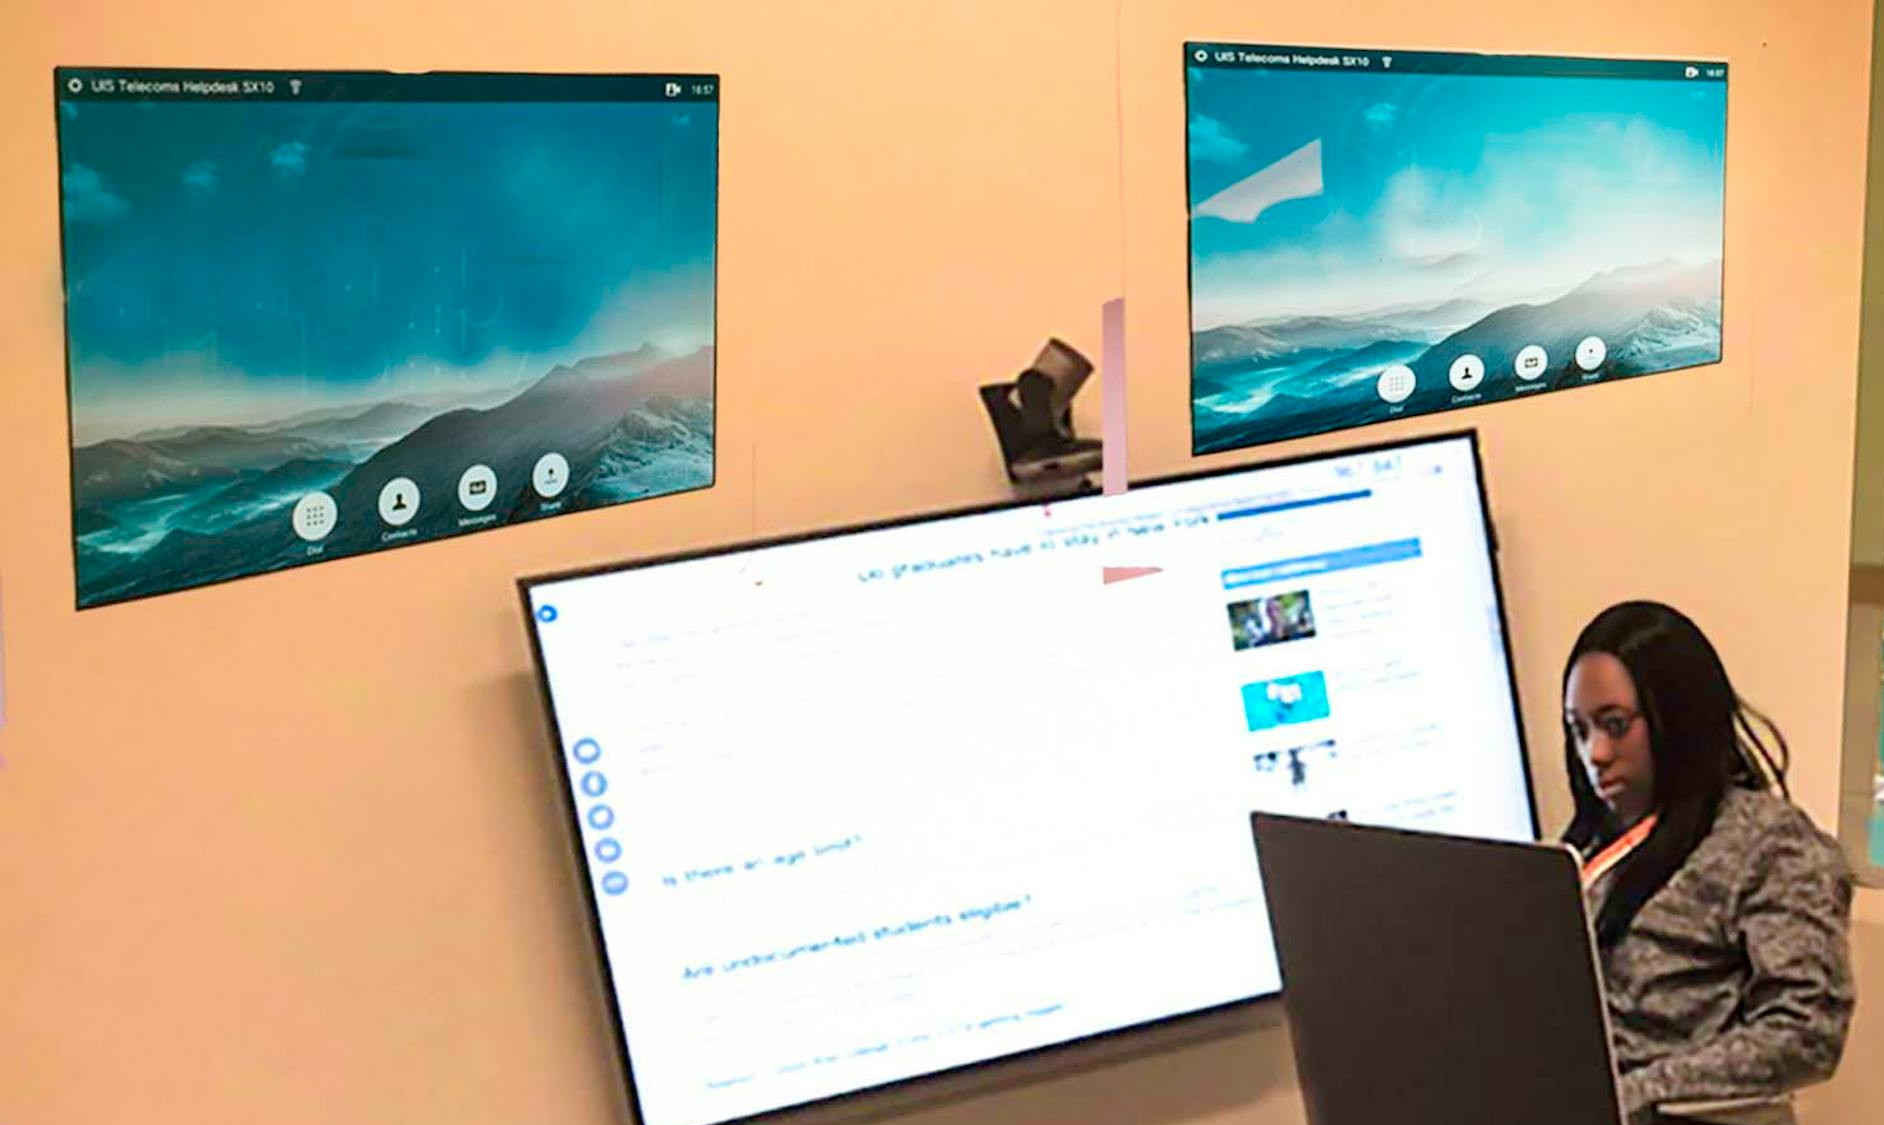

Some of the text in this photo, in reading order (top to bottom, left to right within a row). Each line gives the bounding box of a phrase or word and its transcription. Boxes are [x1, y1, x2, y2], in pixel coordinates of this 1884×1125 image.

[1214, 52, 1370, 67] UIS Telecoms Helpdesk SX10
[91, 79, 275, 95] UIS Telecoms Helpdesk SX10
[873, 915, 952, 941] students
